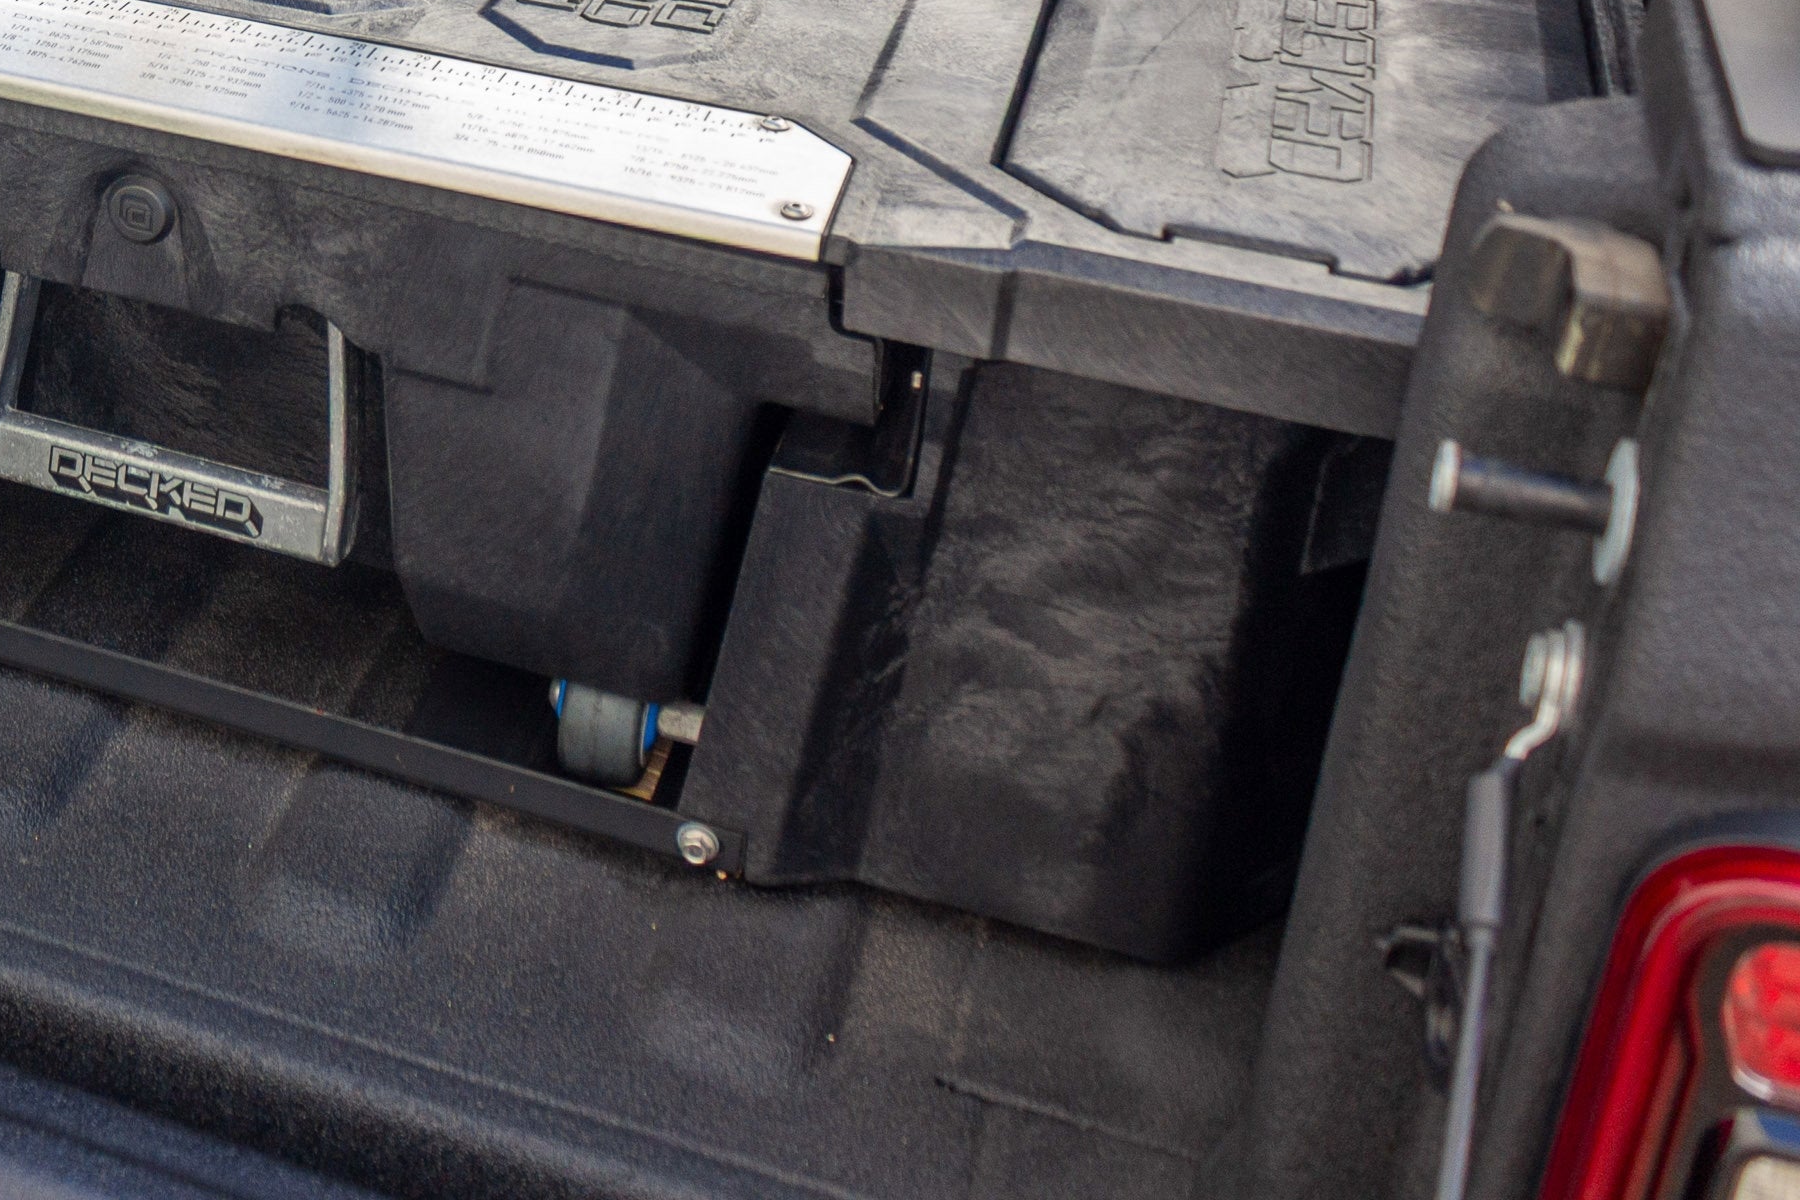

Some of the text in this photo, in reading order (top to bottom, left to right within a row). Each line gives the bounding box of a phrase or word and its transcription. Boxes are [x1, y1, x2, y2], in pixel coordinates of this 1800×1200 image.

[348, 41, 367, 50] 28
[190, 47, 333, 78] FRACTIONS
[49, 445, 264, 538] DECKED
